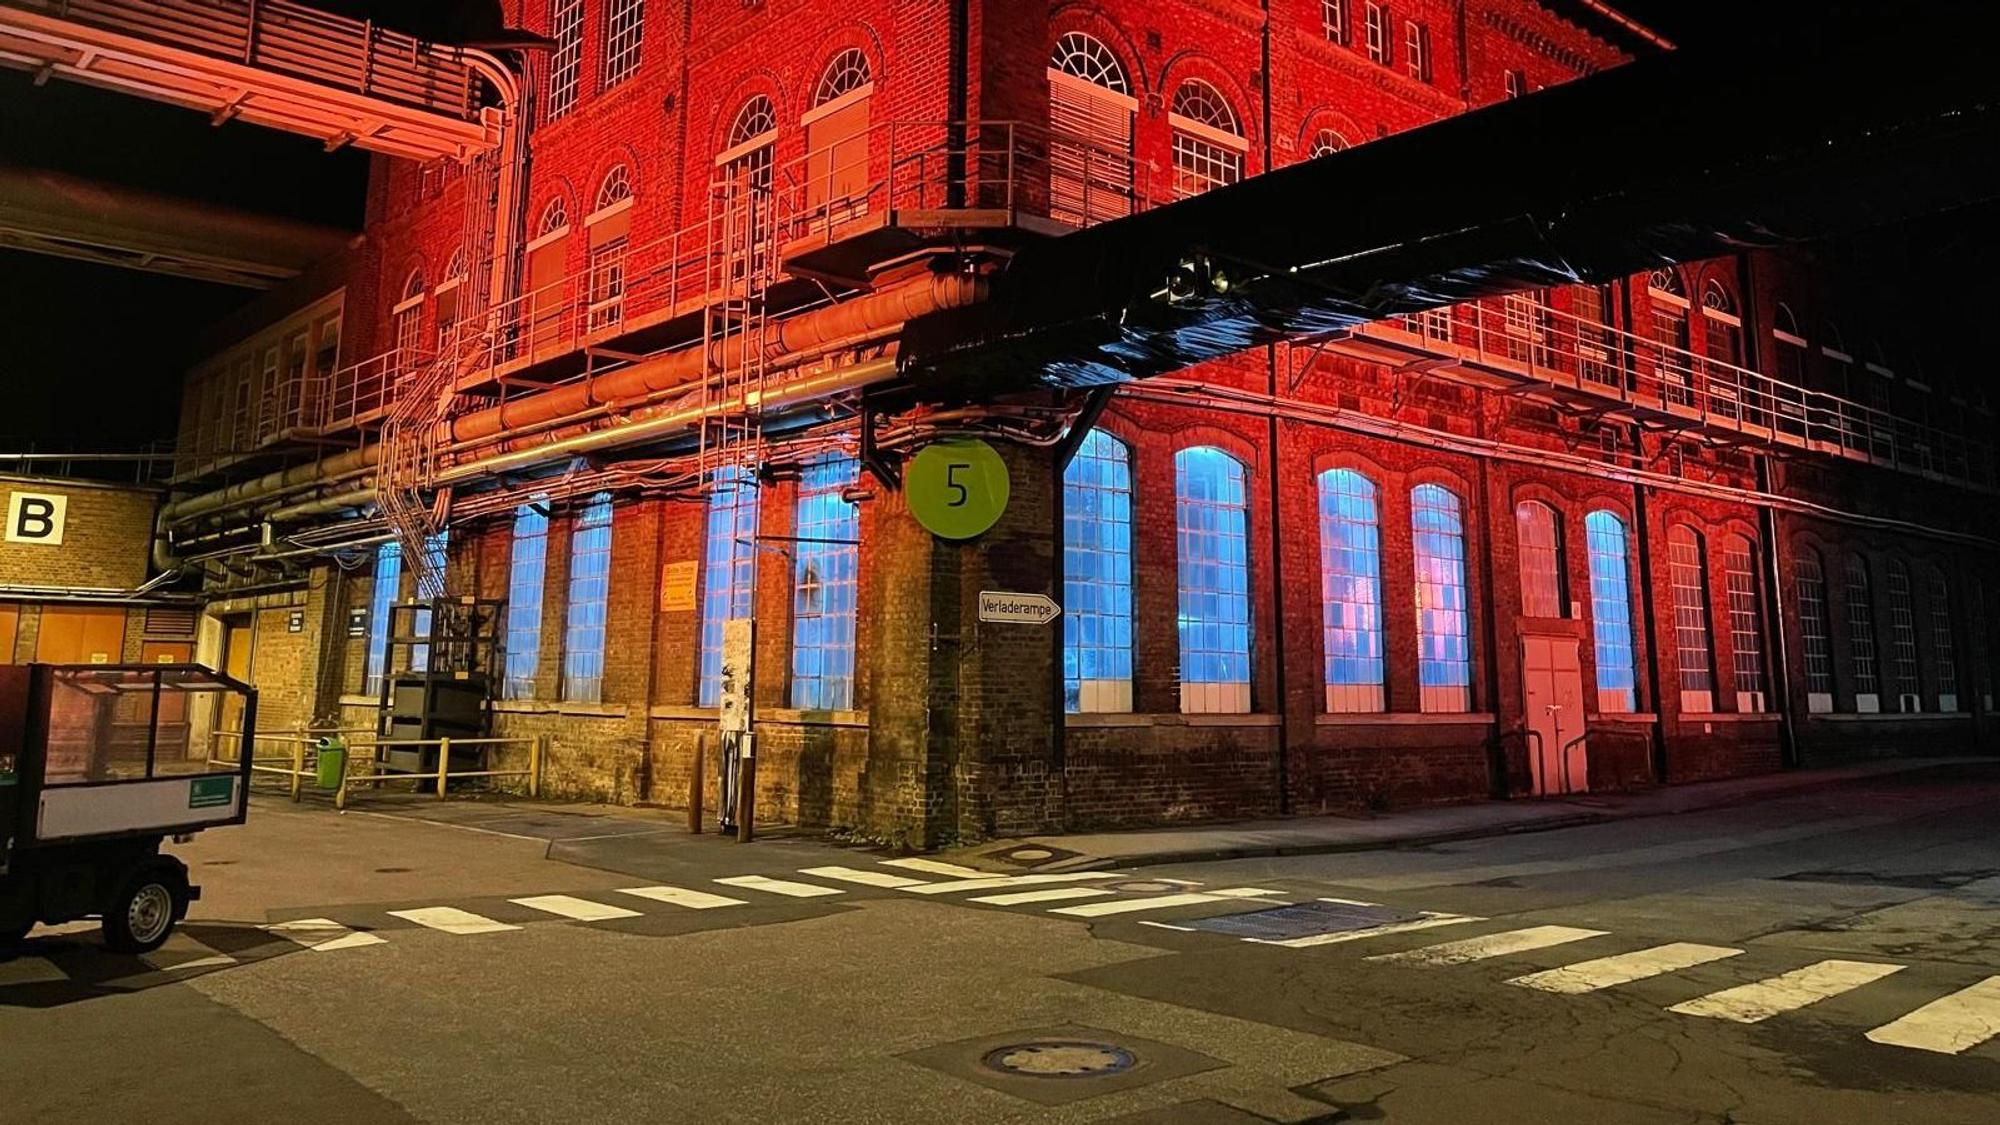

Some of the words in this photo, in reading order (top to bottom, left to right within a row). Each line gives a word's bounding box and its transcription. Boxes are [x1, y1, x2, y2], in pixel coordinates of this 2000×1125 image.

[947, 463, 970, 507] 5
[17, 497, 55, 538] B
[982, 598, 1051, 618] Verladerampe
